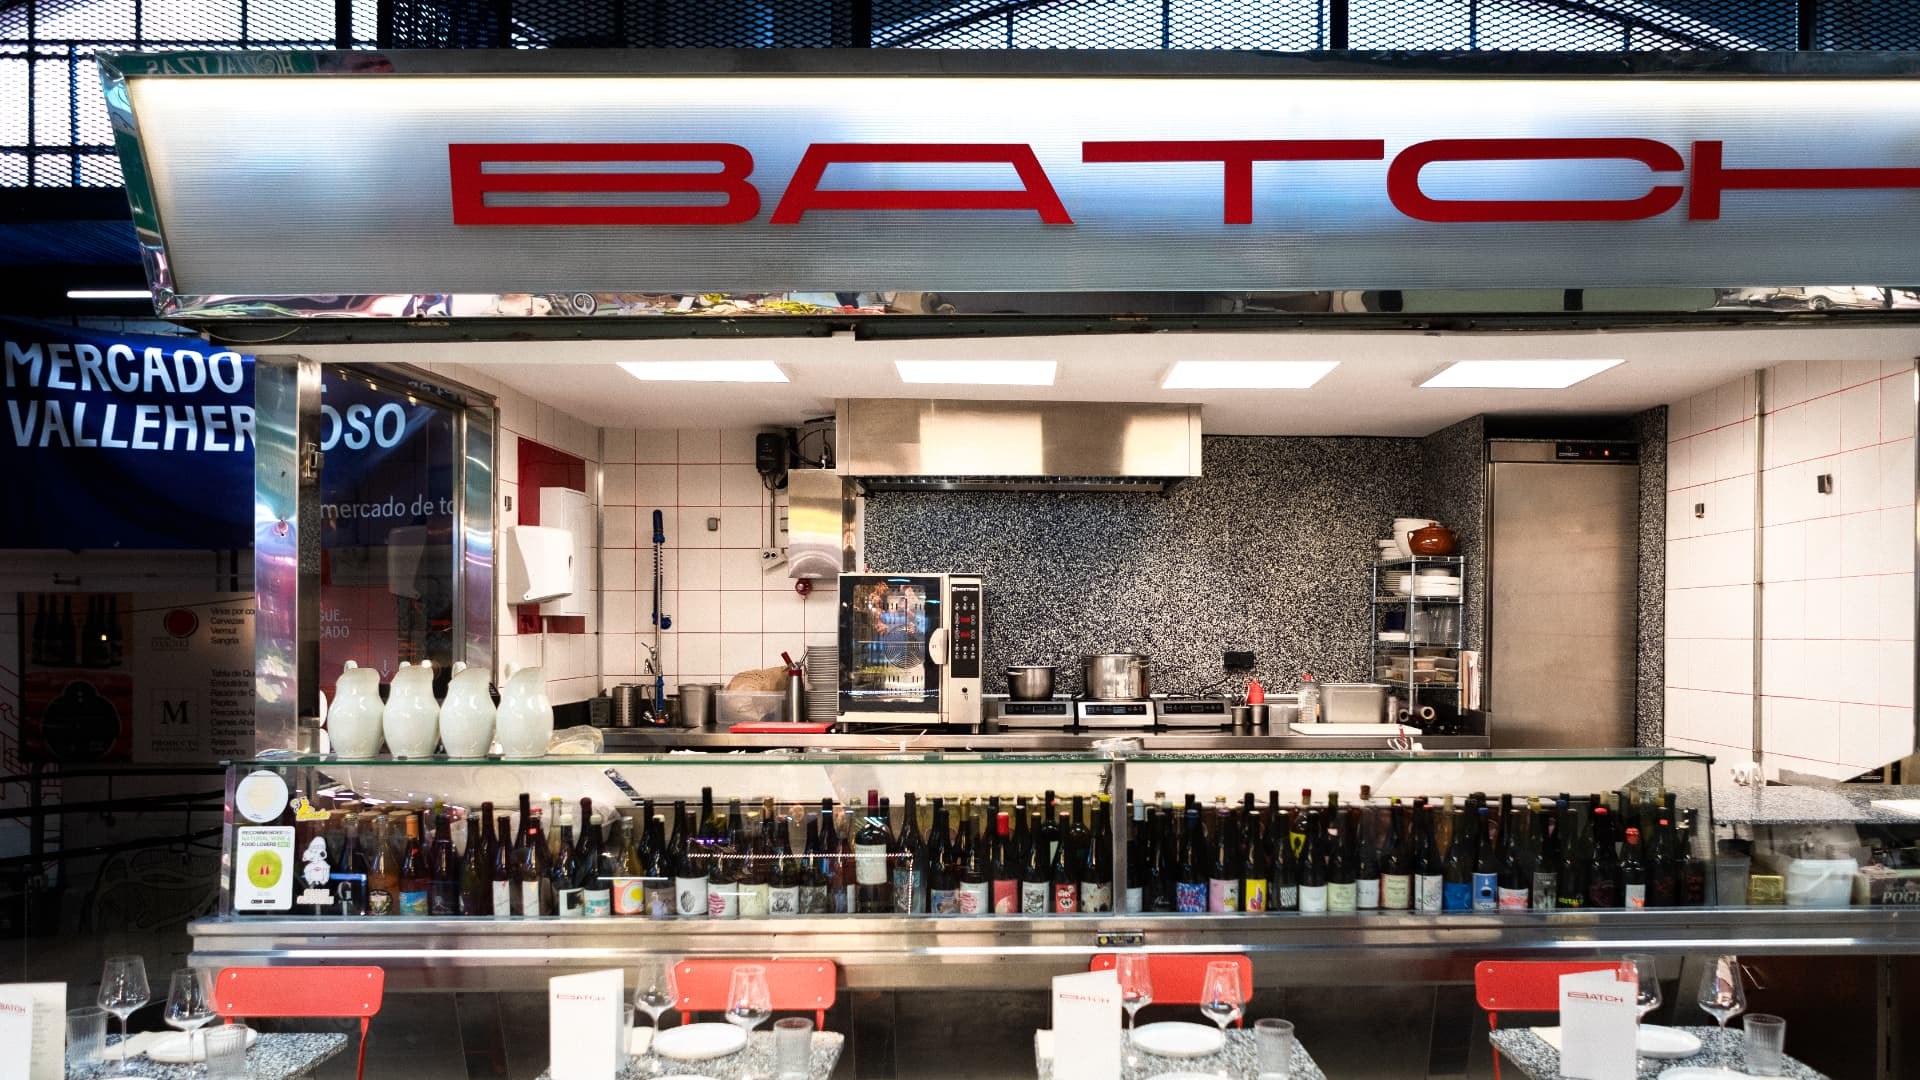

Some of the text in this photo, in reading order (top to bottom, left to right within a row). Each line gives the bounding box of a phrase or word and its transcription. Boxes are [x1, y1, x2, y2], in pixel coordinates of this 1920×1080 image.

[448, 137, 1920, 227] BATCH
[4, 340, 243, 392] MERCADO
[320, 494, 404, 518] mercado
[410, 493, 433, 516] de
[161, 699, 189, 724] M
[0, 1001, 26, 1014] ATCH
[1568, 991, 1623, 1003] BATCH
